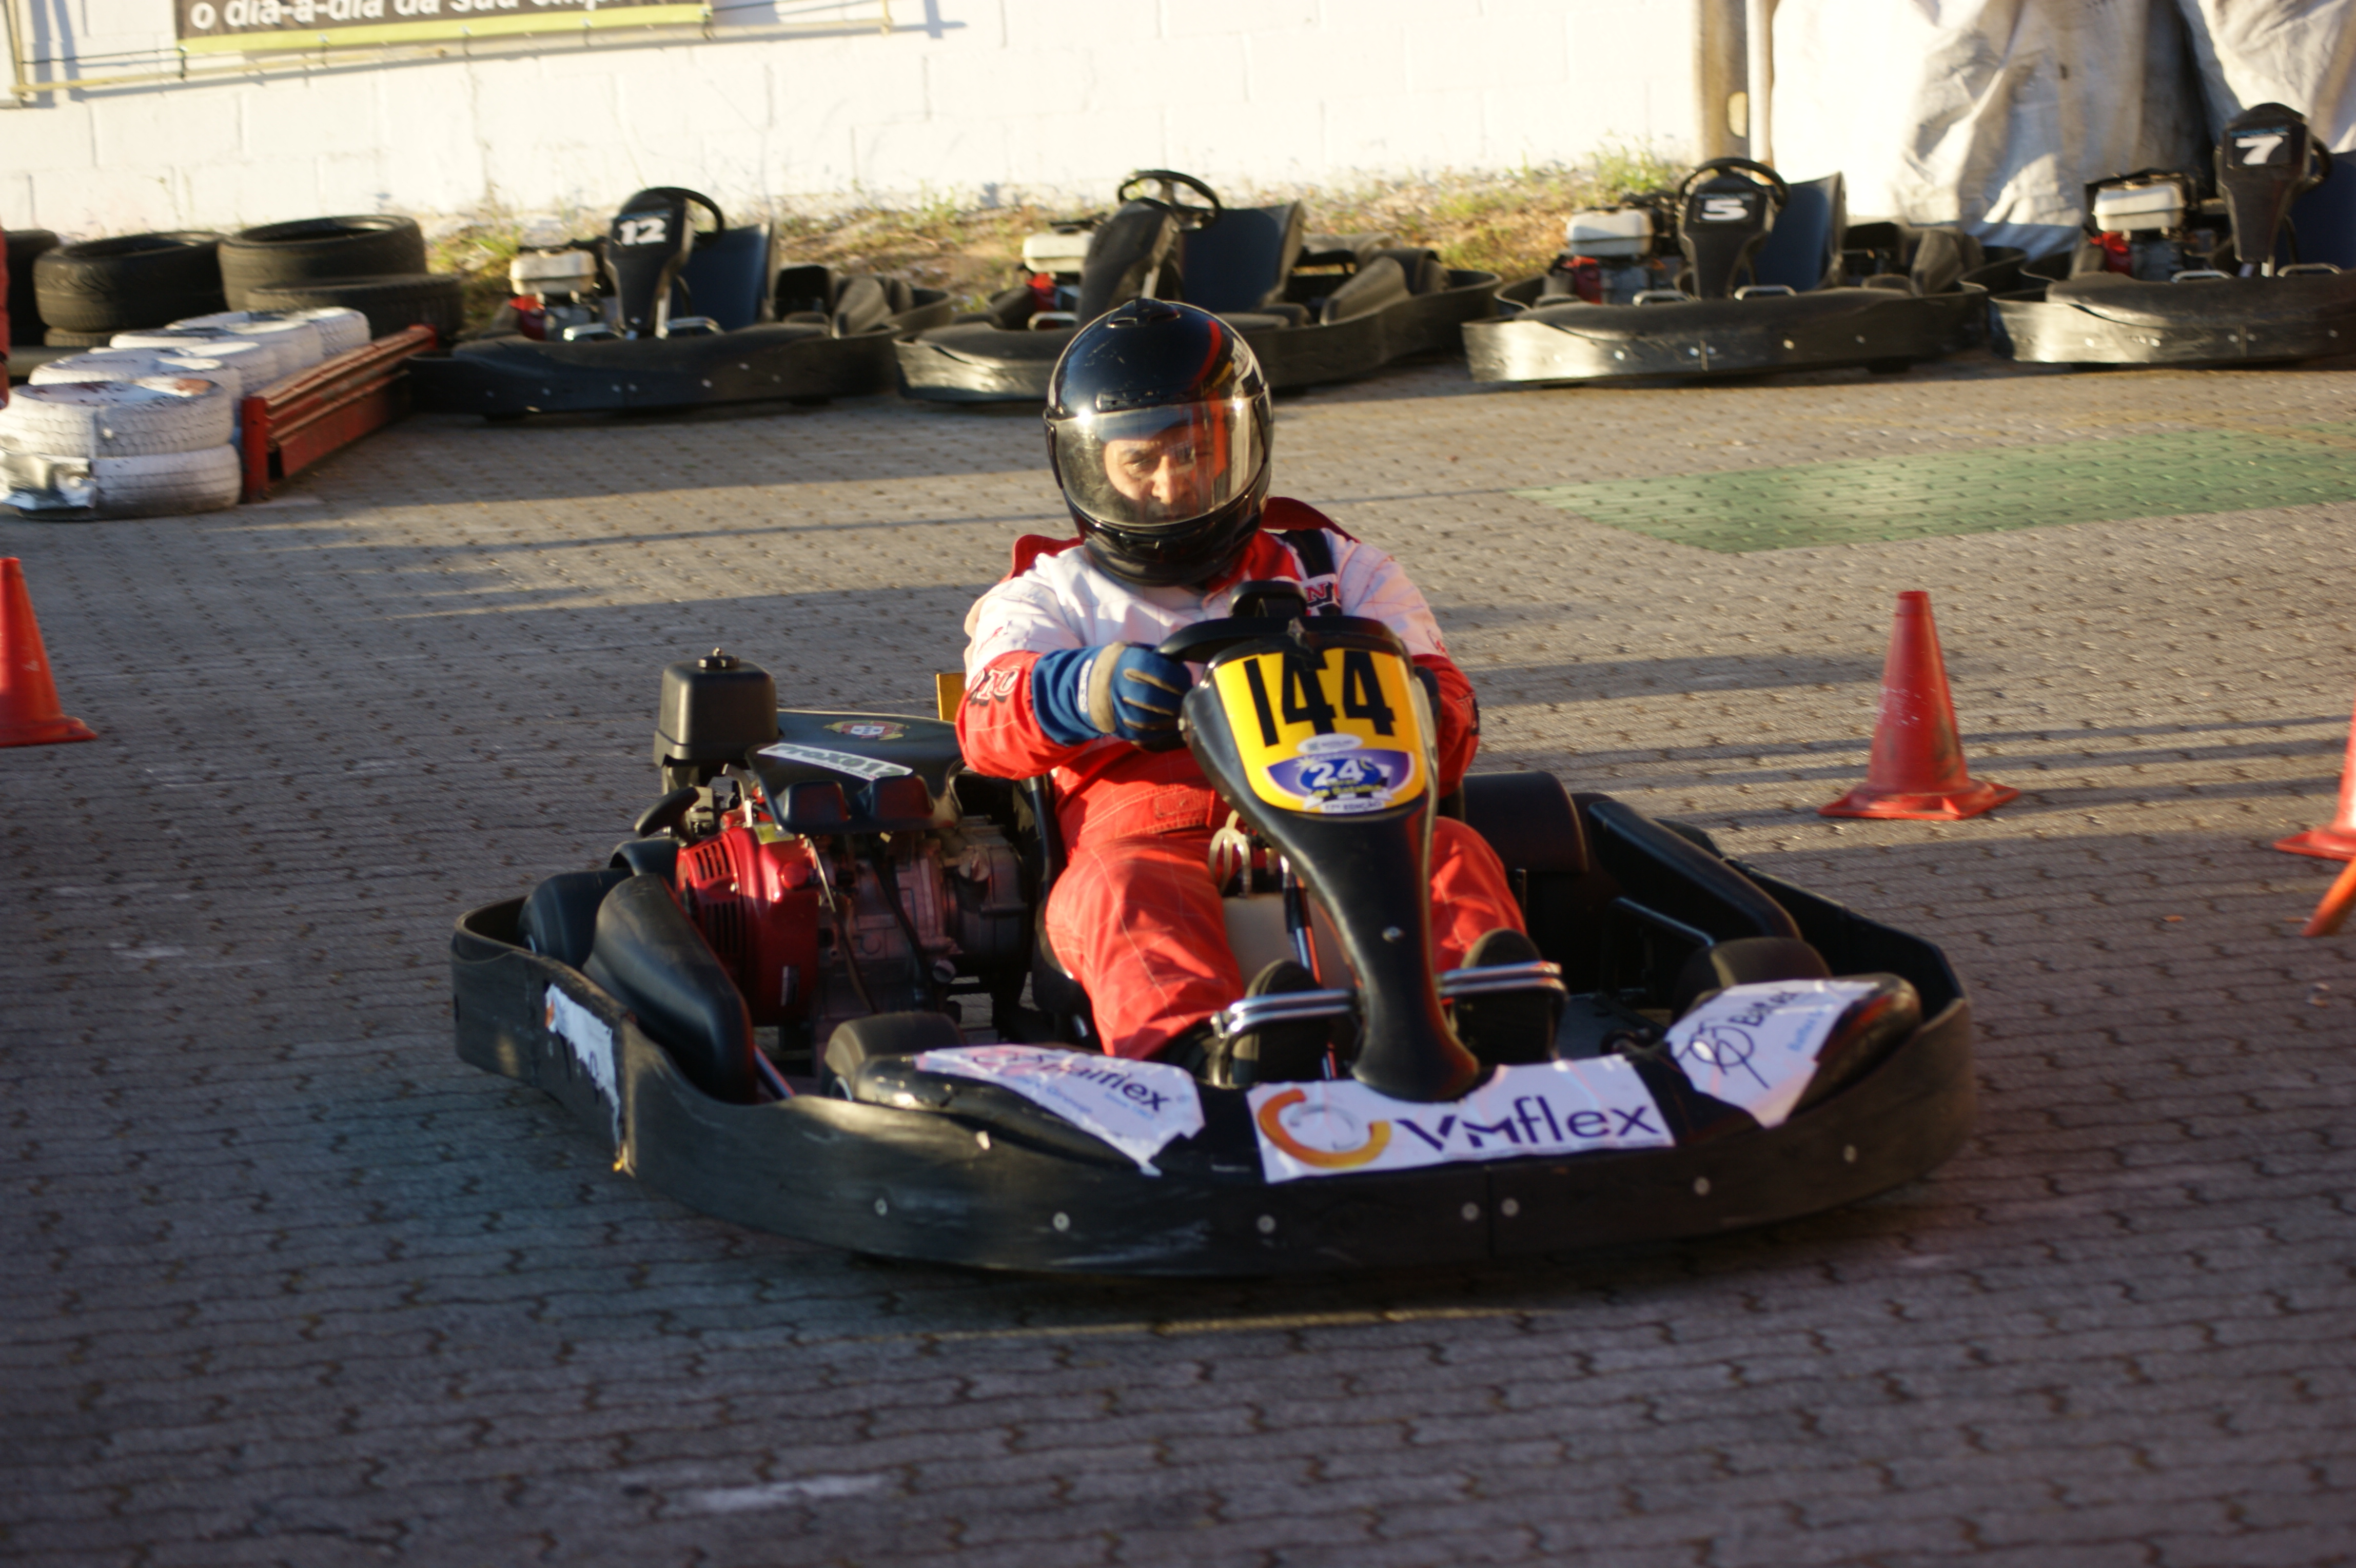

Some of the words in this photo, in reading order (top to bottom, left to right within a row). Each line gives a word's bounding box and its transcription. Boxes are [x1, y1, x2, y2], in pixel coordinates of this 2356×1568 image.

[190, 3, 216, 30] o
[2235, 135, 2284, 165] 7
[1701, 199, 1748, 221] 5
[619, 218, 666, 246] 12
[1243, 650, 1396, 748] 144
[1309, 759, 1366, 788] 24
[1396, 1095, 1661, 1152] VMflex
